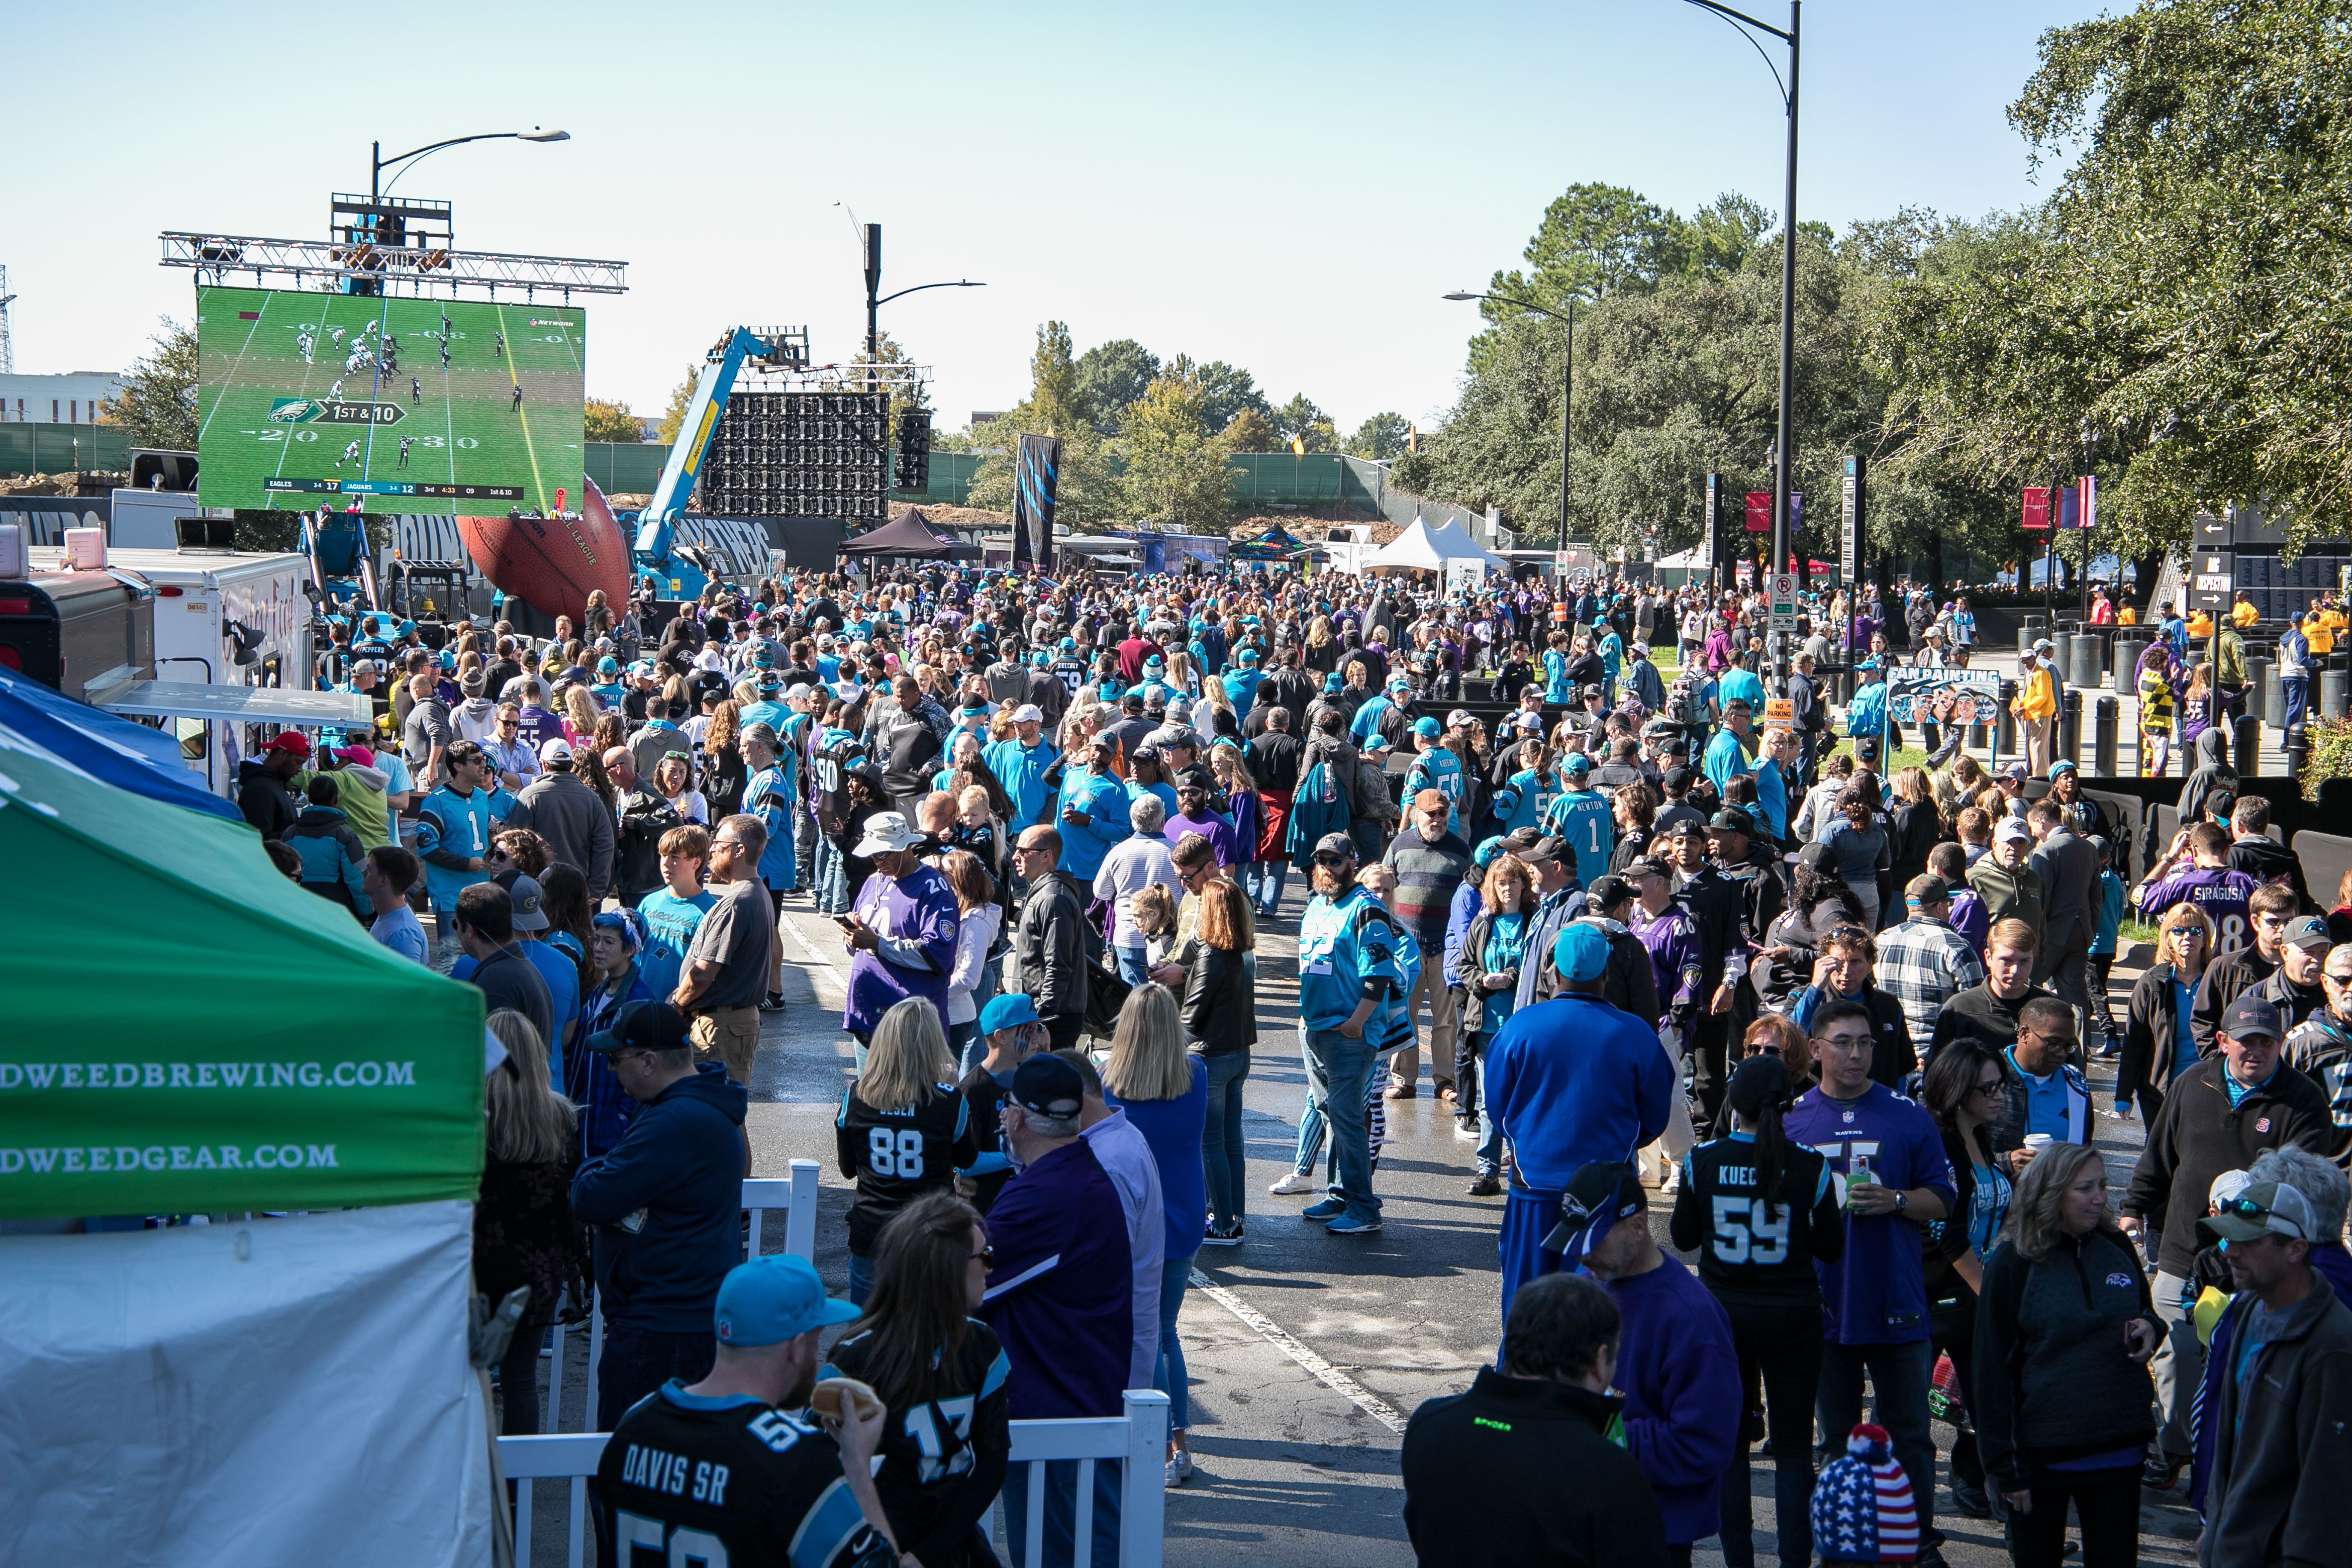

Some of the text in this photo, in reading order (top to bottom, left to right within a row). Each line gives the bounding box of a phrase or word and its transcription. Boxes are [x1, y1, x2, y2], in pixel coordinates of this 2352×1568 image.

[333, 405, 395, 421] 1ST & 10
[327, 482, 338, 491] 17
[402, 485, 414, 493] 12
[475, 520, 514, 567] PANTHERS
[571, 527, 598, 567] LEAGUE
[673, 518, 770, 574] ANTHERS
[2196, 574, 2232, 592] INSPECTION
[1889, 666, 1999, 682] FAN PAINTING
[517, 729, 541, 752] 55
[815, 758, 838, 793] 90
[1439, 759, 1456, 768] KUECHLY
[1576, 801, 1603, 813] NEWTON
[1872, 813, 1887, 824] EWIS
[467, 810, 484, 852] 1
[1589, 818, 1599, 853] 1
[925, 876, 948, 895] 20
[1958, 891, 1978, 903] 57
[2194, 887, 2245, 902] SIRAGUSA
[1299, 923, 1339, 977] 22
[0, 1060, 416, 1090] DWEEDBREWING.COM
[0, 1143, 340, 1174] DWEEDGEAR.COM
[868, 1126, 924, 1181] 88
[1711, 1195, 1791, 1265] 59
[1474, 1417, 1512, 1432] SPYDER
[622, 1442, 731, 1507] DAVIS SR
